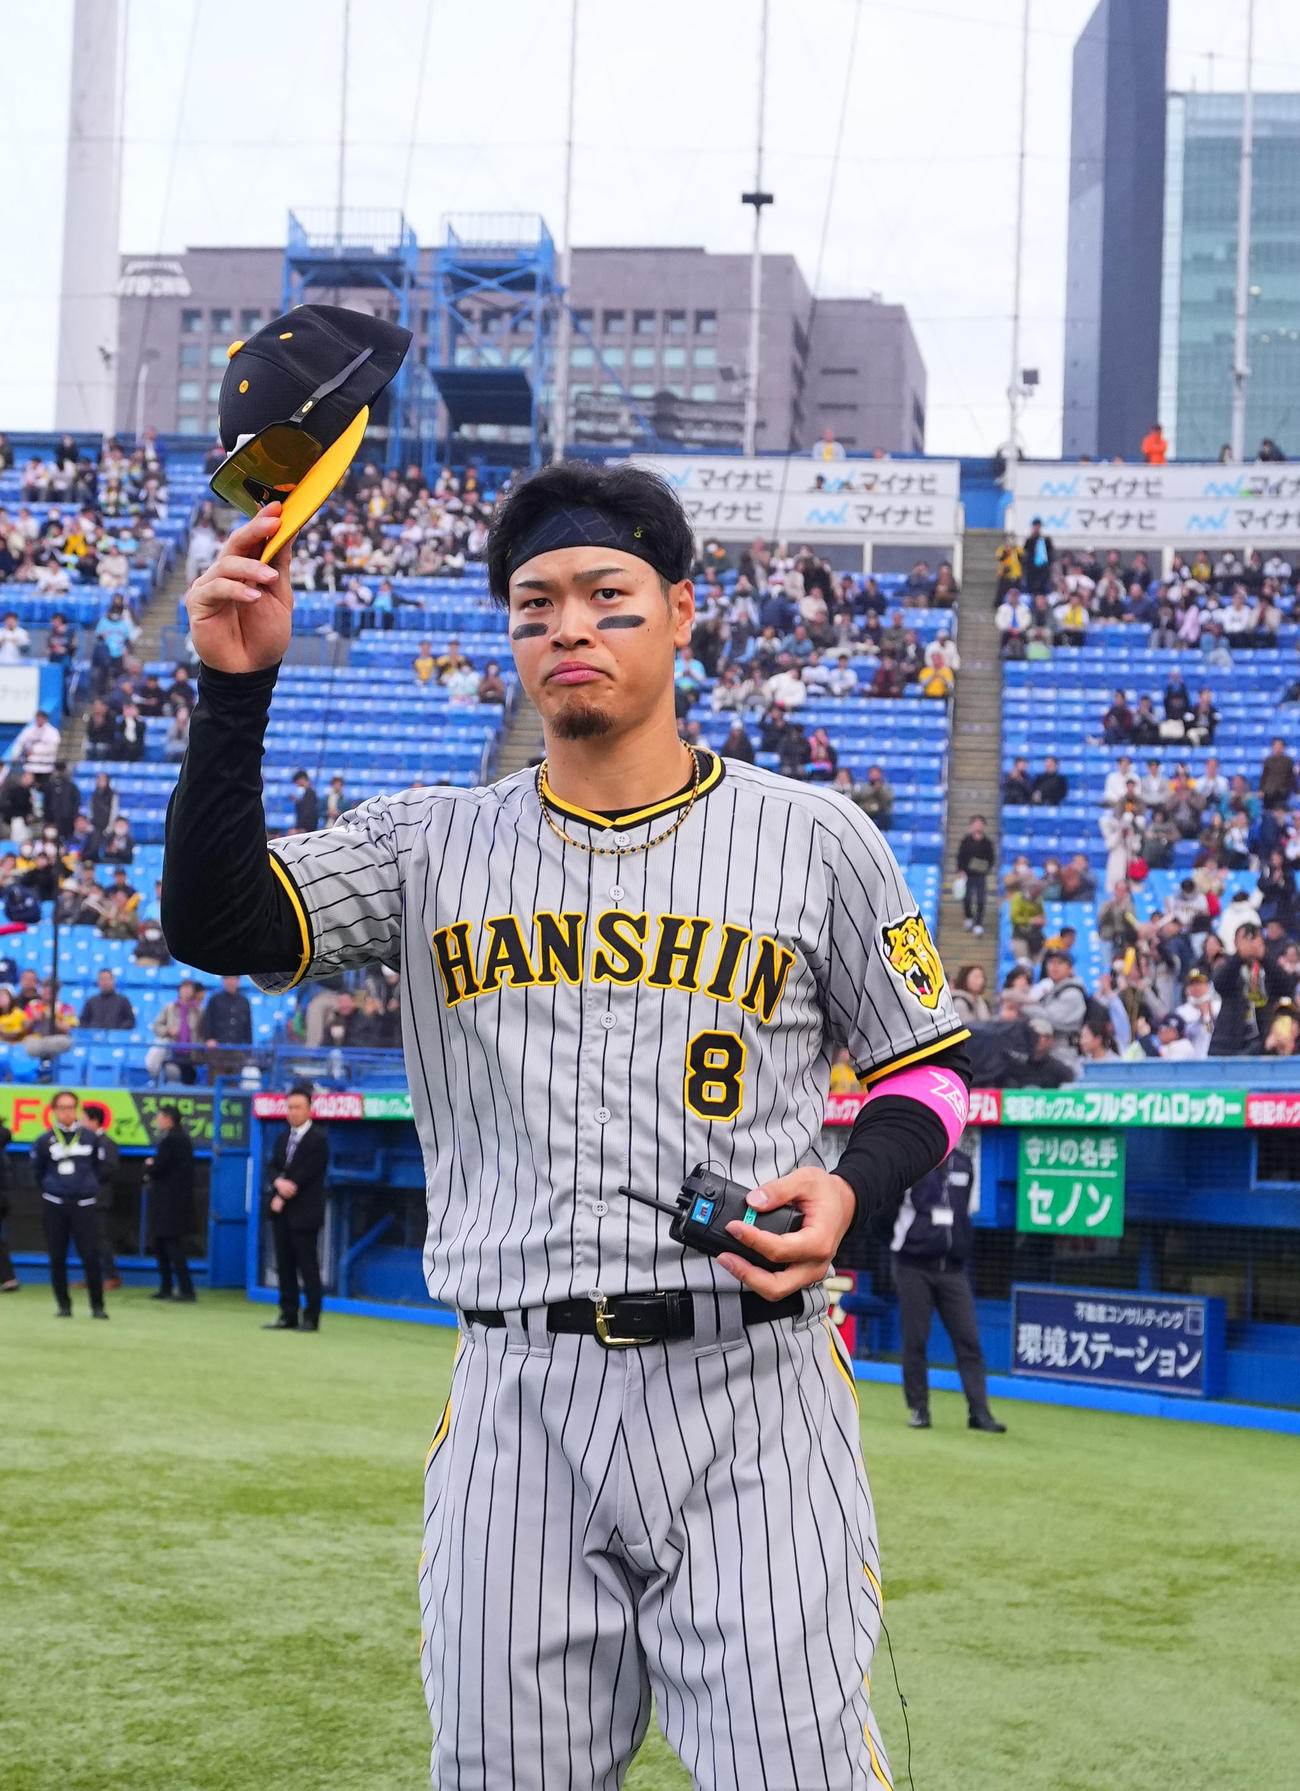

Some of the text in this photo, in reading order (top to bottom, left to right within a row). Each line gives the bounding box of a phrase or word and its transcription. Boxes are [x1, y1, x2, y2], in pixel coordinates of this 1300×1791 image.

[698, 468, 774, 489] マイナビ
[1085, 476, 1163, 497] マイナビ
[685, 499, 763, 522] マイナビ
[854, 504, 935, 527] マイナビ
[1076, 508, 1157, 531] マイナビ
[433, 910, 794, 1022] HANSHIN
[684, 1030, 746, 1120] 8
[1025, 1136, 1118, 1168] 守りの名手
[1027, 1180, 1113, 1227] セノン
[1074, 1301, 1184, 1330] 不動産コンサルティング
[1017, 1323, 1202, 1379] 環境ステーション
